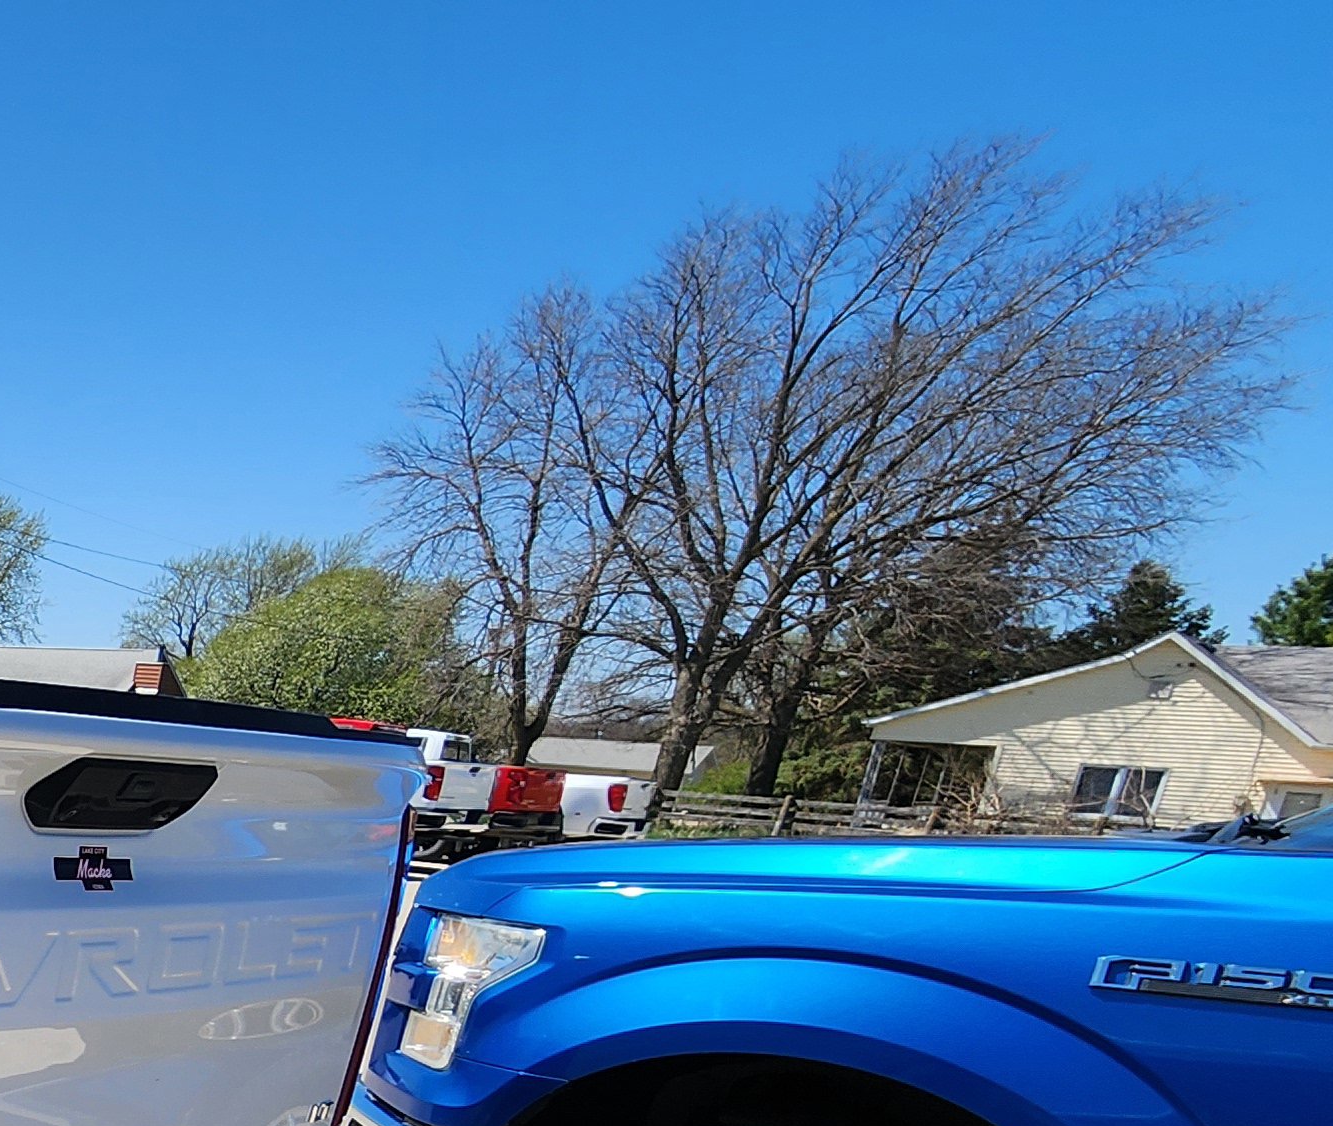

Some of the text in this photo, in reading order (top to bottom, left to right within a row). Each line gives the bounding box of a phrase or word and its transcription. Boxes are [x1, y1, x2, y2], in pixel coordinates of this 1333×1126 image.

[81, 847, 105, 855] LAKE CITY
[76, 858, 113, 879] Macke
